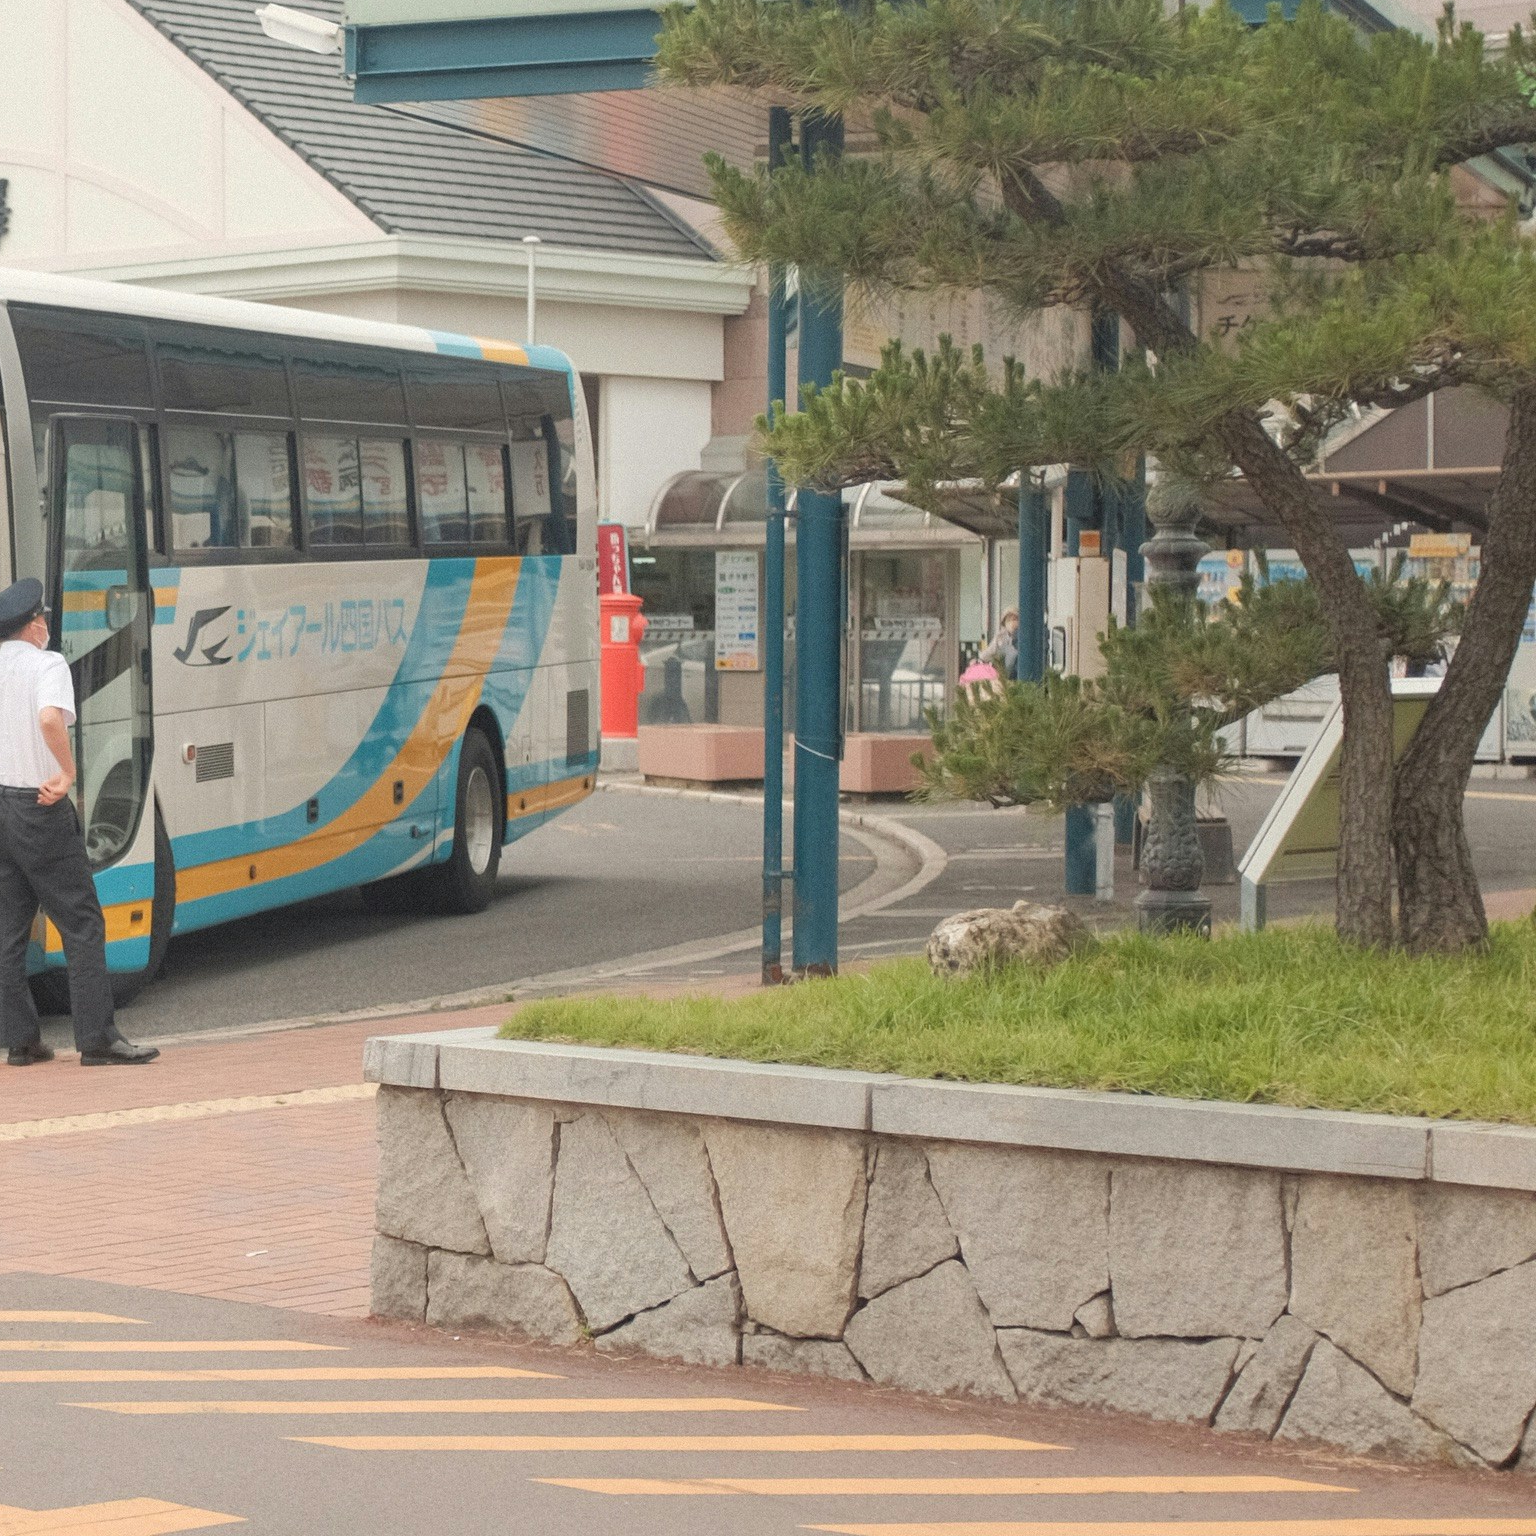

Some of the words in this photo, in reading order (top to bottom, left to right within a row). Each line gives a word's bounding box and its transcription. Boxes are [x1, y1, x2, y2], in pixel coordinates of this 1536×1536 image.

[236, 598, 409, 663] ジェイアール四国バス
